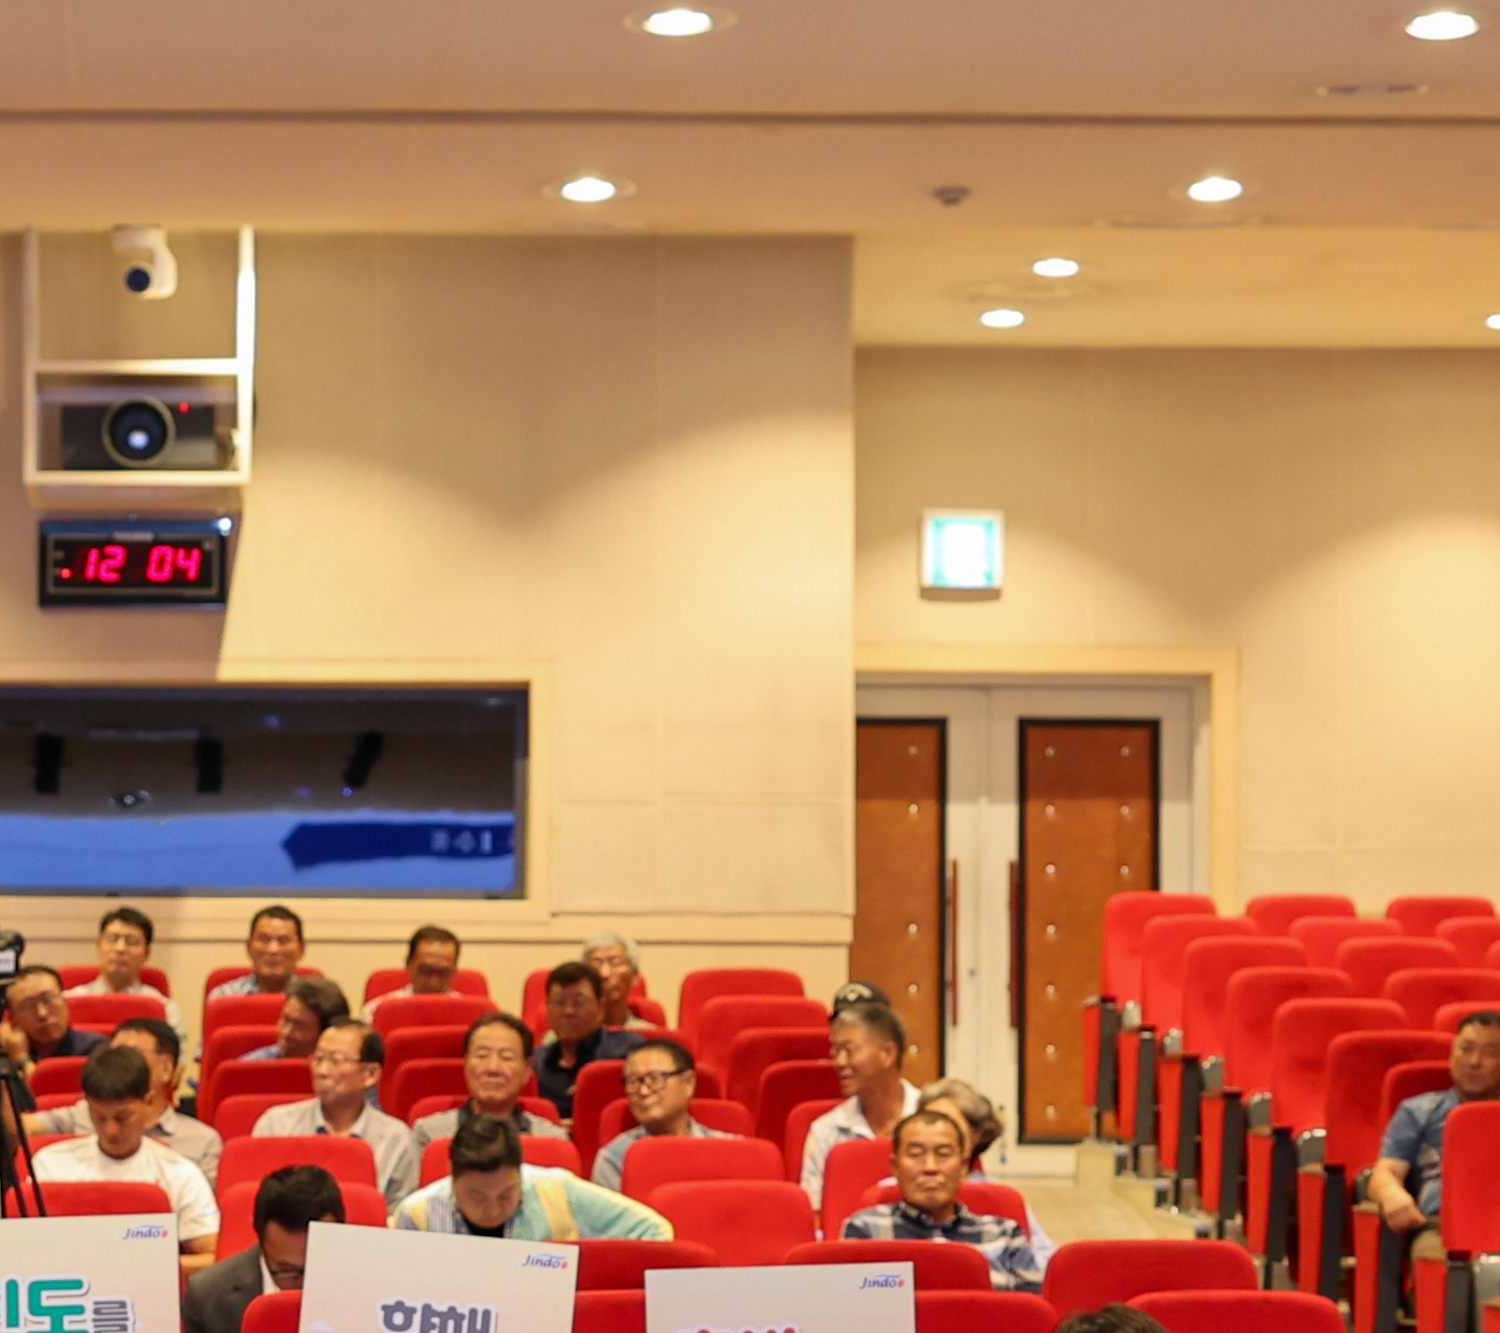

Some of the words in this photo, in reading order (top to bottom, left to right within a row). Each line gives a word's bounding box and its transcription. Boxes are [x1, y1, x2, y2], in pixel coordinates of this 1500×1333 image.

[84, 544, 127, 583] 12
[146, 544, 202, 583] 04
[121, 1226, 161, 1241] Jindo
[521, 1254, 562, 1270] Jindo
[859, 1275, 899, 1290] Jindo
